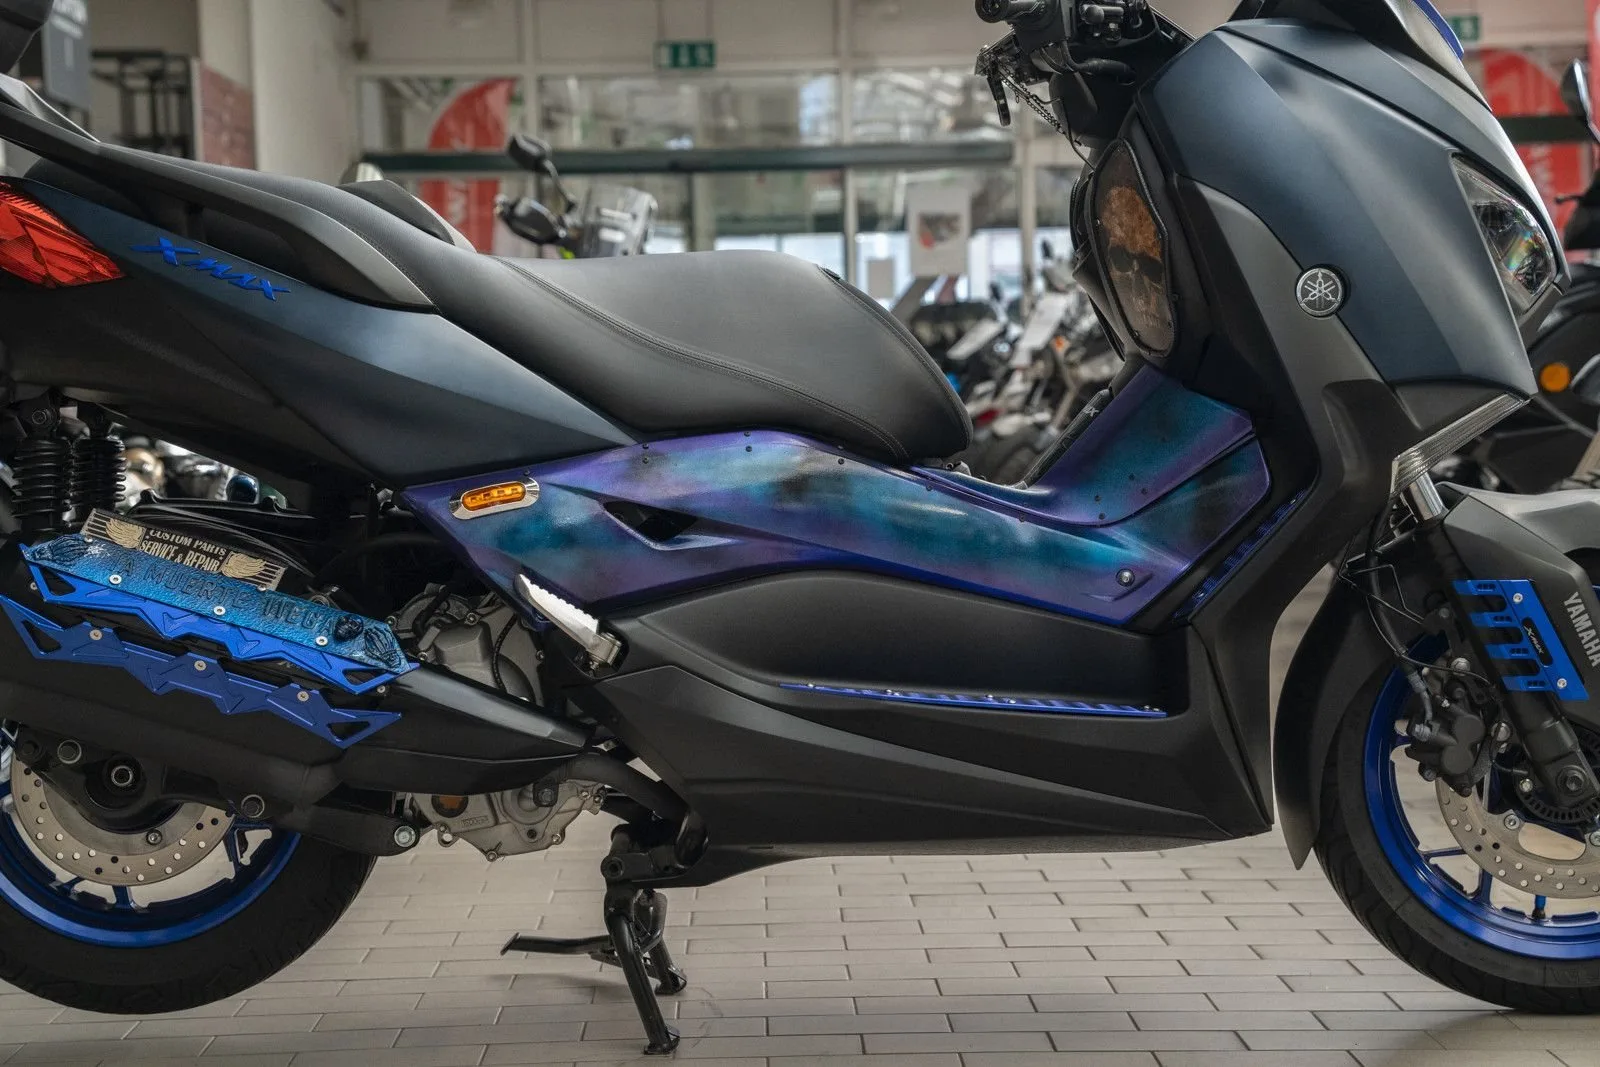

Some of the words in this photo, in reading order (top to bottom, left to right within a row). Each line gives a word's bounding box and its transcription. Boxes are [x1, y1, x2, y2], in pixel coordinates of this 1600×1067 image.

[139, 540, 179, 561] SERVICE
[182, 550, 220, 572] REPAIR
[149, 529, 193, 547] CUSTOM
[193, 539, 227, 556] PARTS
[142, 566, 255, 610] MUERTE
[1563, 591, 1600, 667] YAMAHA
